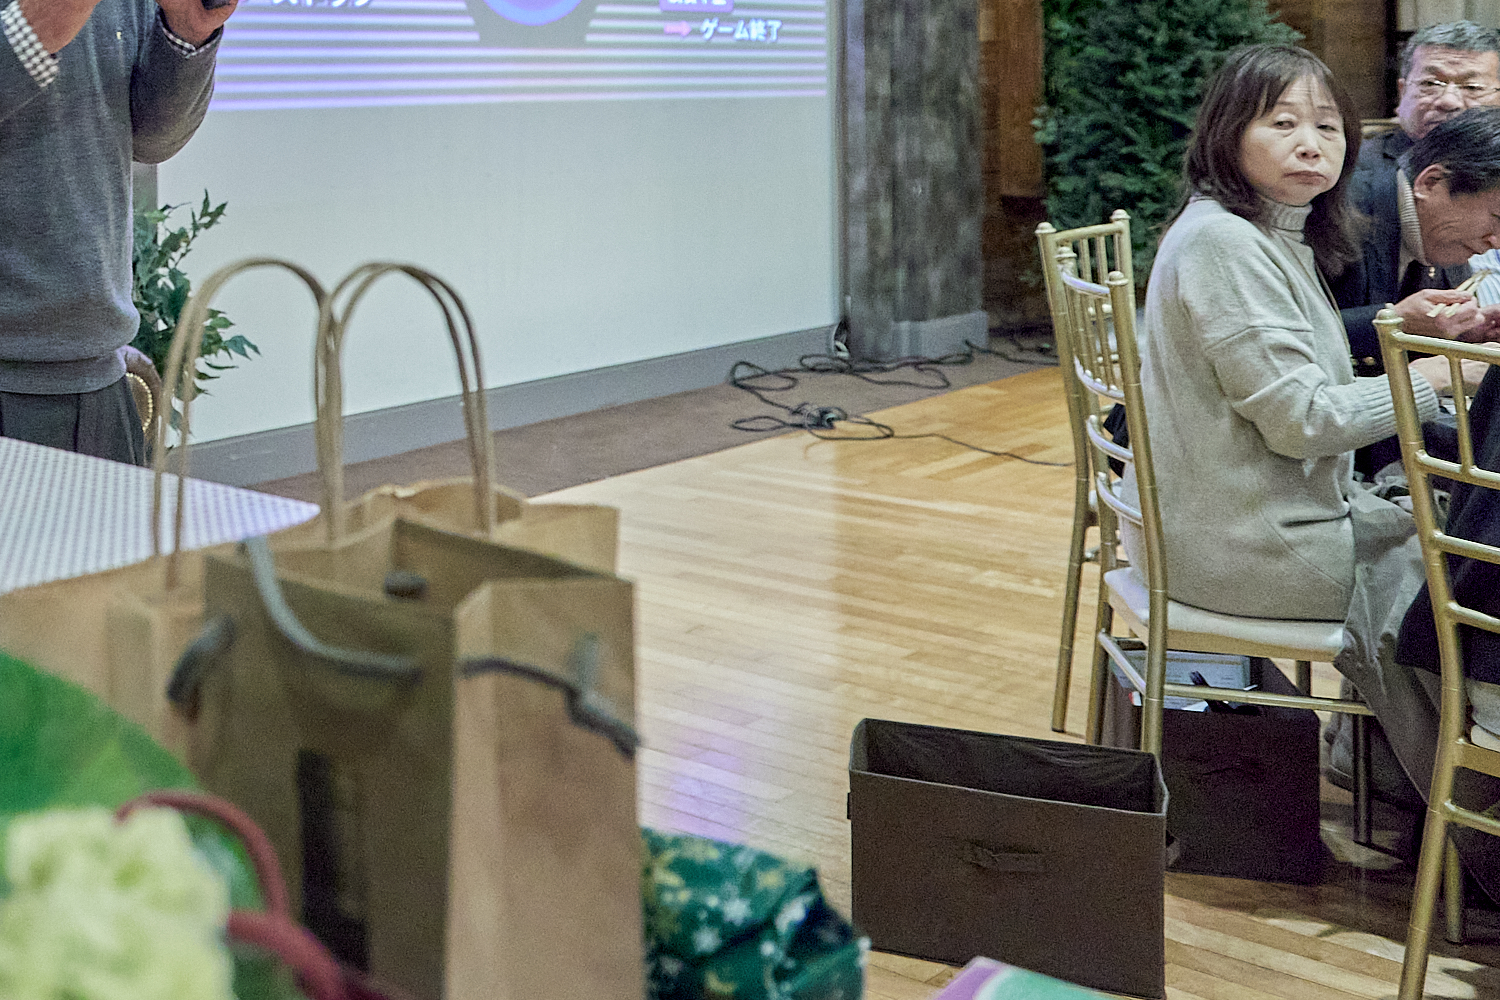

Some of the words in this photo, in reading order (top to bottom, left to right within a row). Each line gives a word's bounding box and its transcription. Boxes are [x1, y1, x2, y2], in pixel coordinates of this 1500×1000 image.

[700, 17, 783, 42] ゲーム終了
